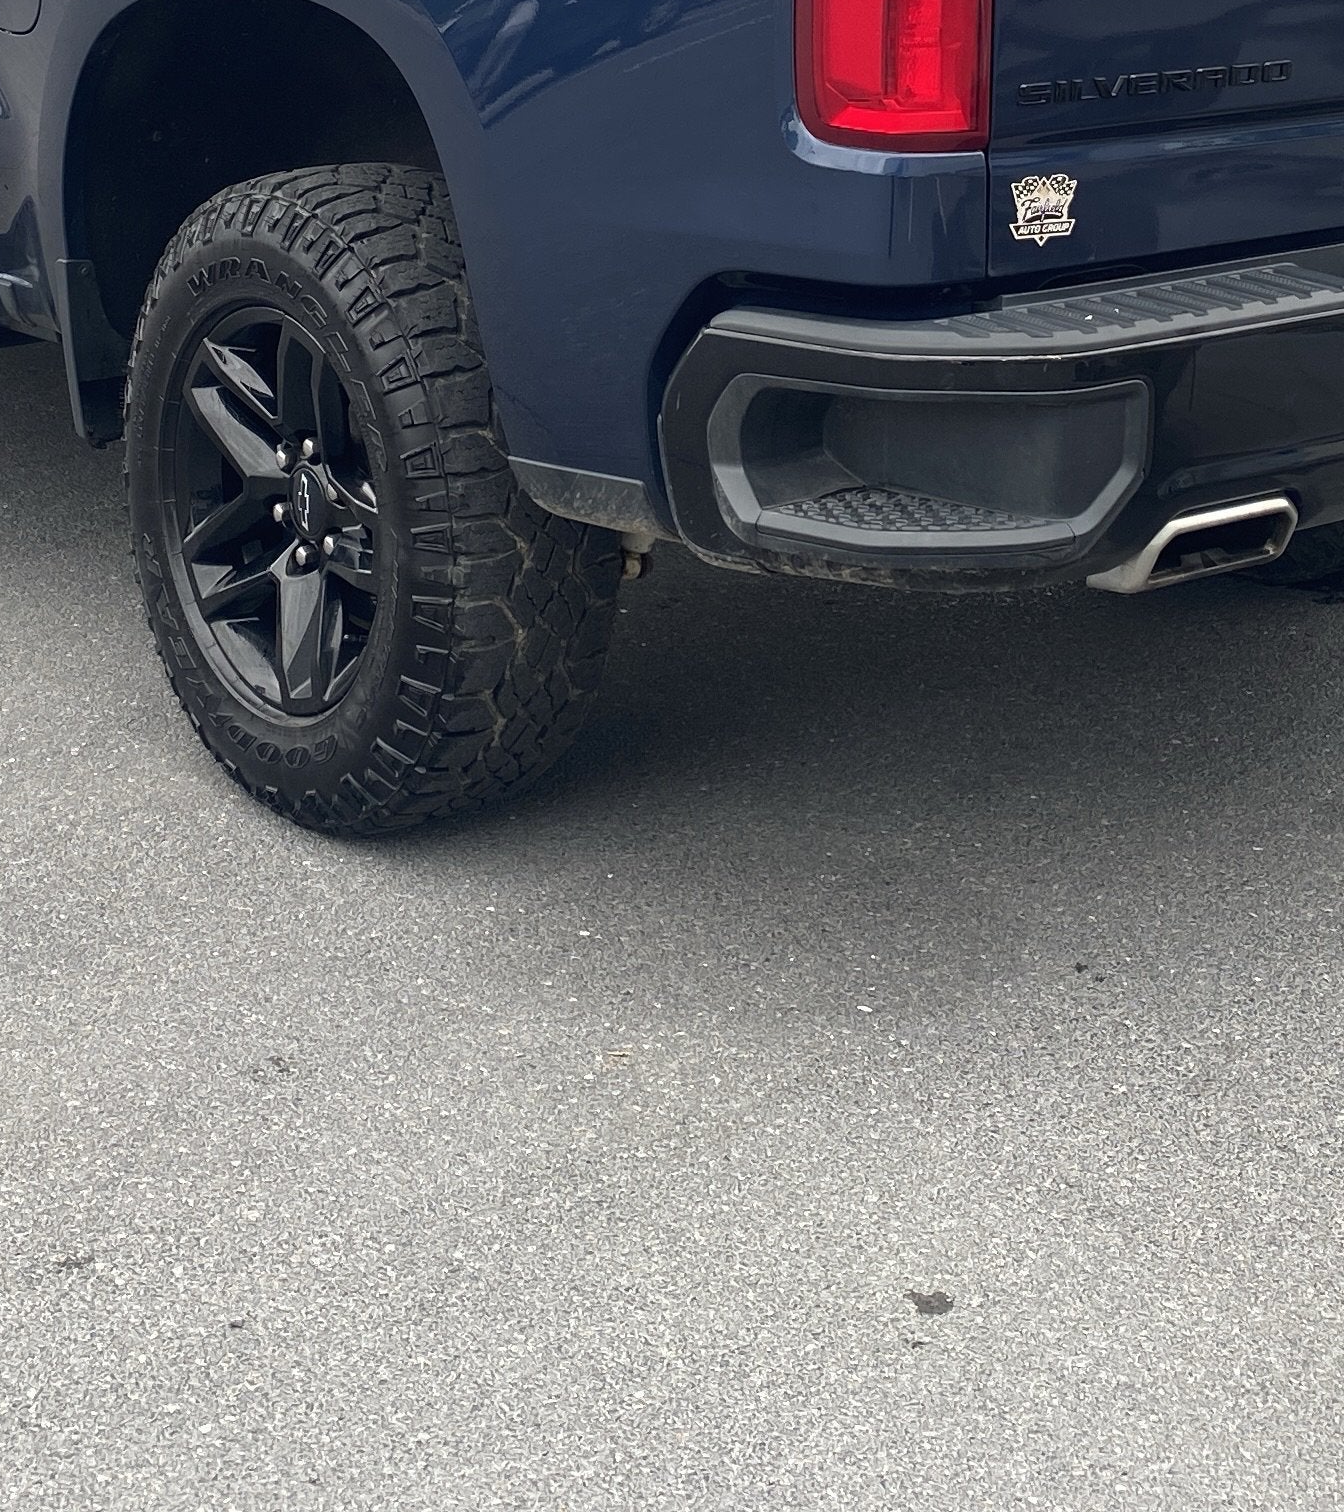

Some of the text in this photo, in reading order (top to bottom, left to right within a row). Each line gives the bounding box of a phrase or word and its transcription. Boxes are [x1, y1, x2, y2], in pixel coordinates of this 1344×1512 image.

[1016, 59, 1293, 105] SILVERADO
[1017, 222, 1070, 235] AUTO GROUP
[186, 253, 388, 471] WRANGLER
